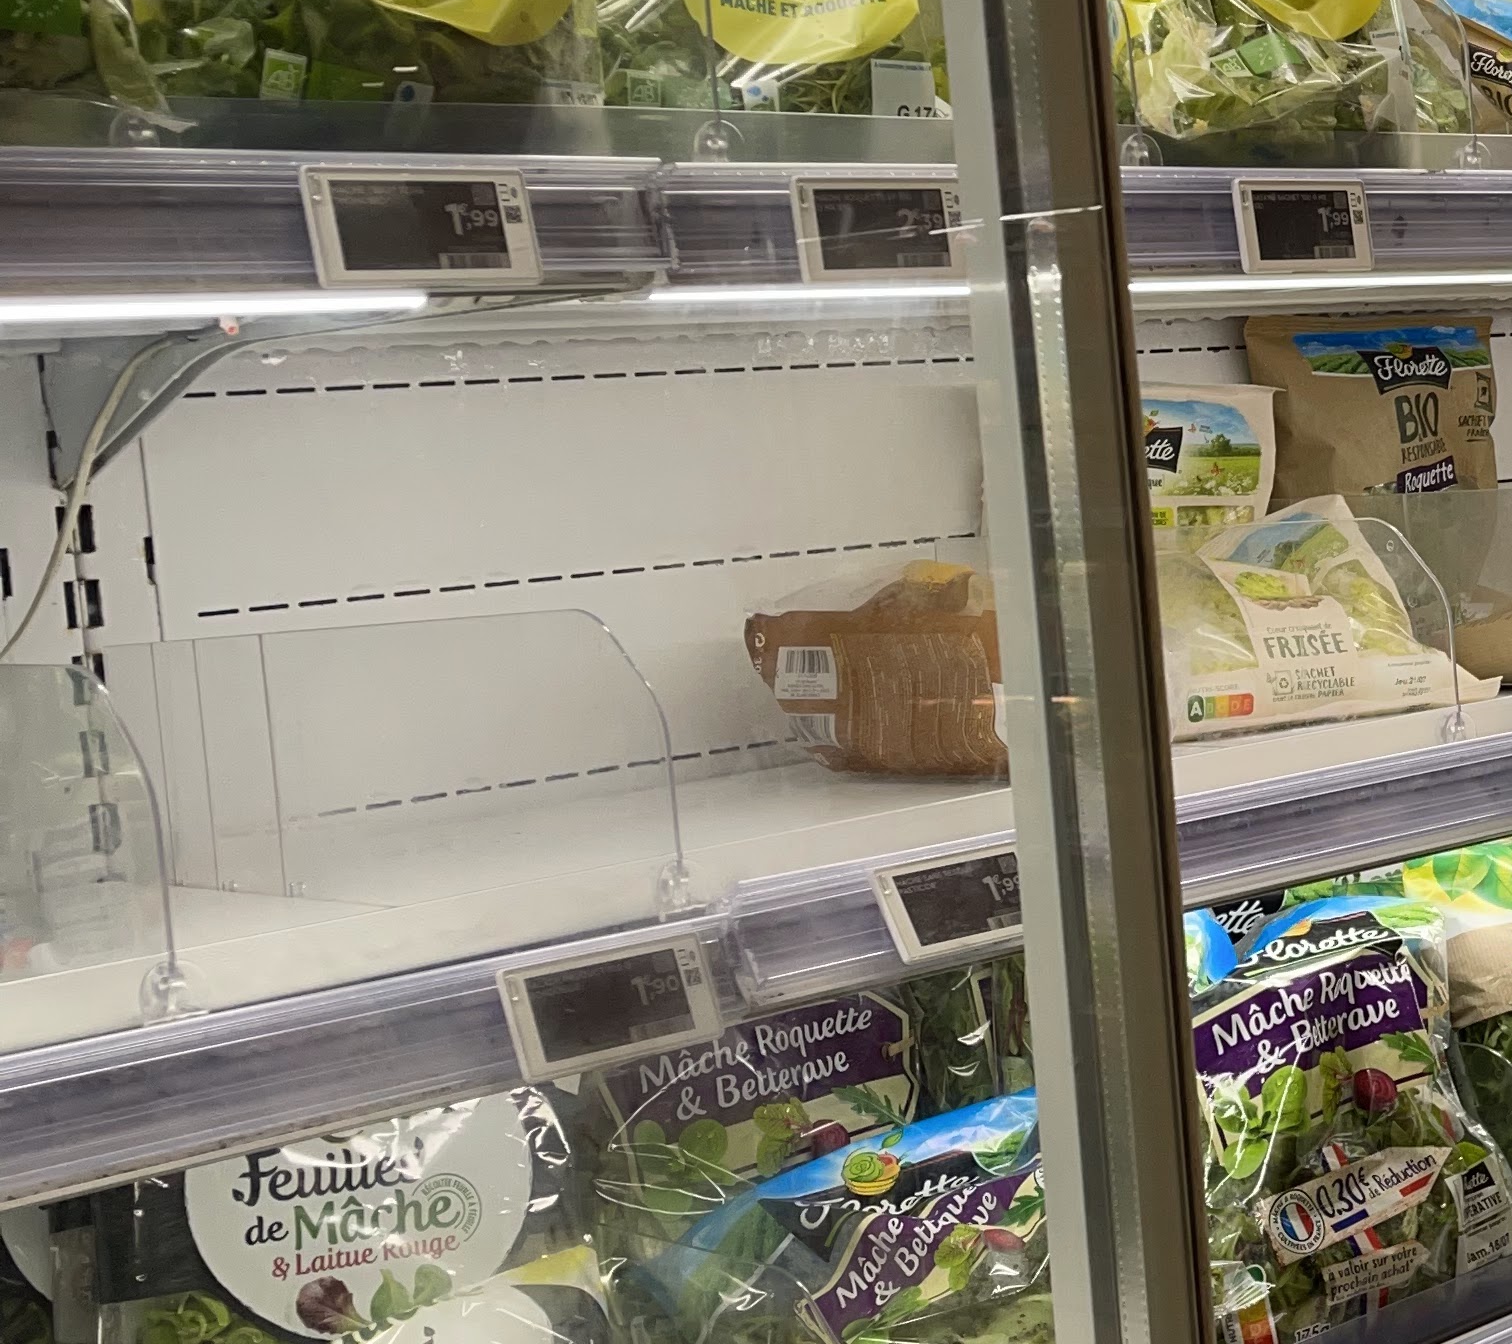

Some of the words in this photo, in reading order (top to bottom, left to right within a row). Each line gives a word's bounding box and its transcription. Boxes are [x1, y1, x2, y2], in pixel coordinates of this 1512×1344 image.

[780, 5, 798, 19] ET
[1374, 354, 1448, 381] Florette
[1394, 391, 1439, 444] BIO
[1404, 462, 1454, 494] Roquette
[1263, 629, 1348, 659] FRISÉE
[1295, 666, 1336, 680] SACHET
[1297, 676, 1356, 691] RECYCLABLE
[1214, 899, 1266, 937] ette
[1211, 987, 1314, 1056] Mâche
[1319, 958, 1412, 1004] Roquette
[638, 1039, 750, 1096] Mâche
[755, 1006, 874, 1057] Roquette
[1256, 1038, 1287, 1075] &
[1289, 997, 1400, 1053] Betterave
[675, 1086, 707, 1122] &
[715, 1048, 850, 1109] Betterave
[232, 1137, 430, 1204] Feuilles
[1368, 1186, 1380, 1199] de
[1374, 1154, 1438, 1197] Réduction
[245, 1215, 290, 1246] de
[293, 1191, 462, 1251] Mâche
[271, 1256, 291, 1279] &
[294, 1244, 379, 1277] Laitue
[383, 1233, 461, 1265] Rouge
[835, 1216, 905, 1309] Mâche
[1335, 1259, 1370, 1281] valoir
[1371, 1255, 1390, 1272] sur
[1391, 1245, 1418, 1266] votre
[872, 1277, 901, 1307] &
[1329, 1274, 1380, 1298] prochain
